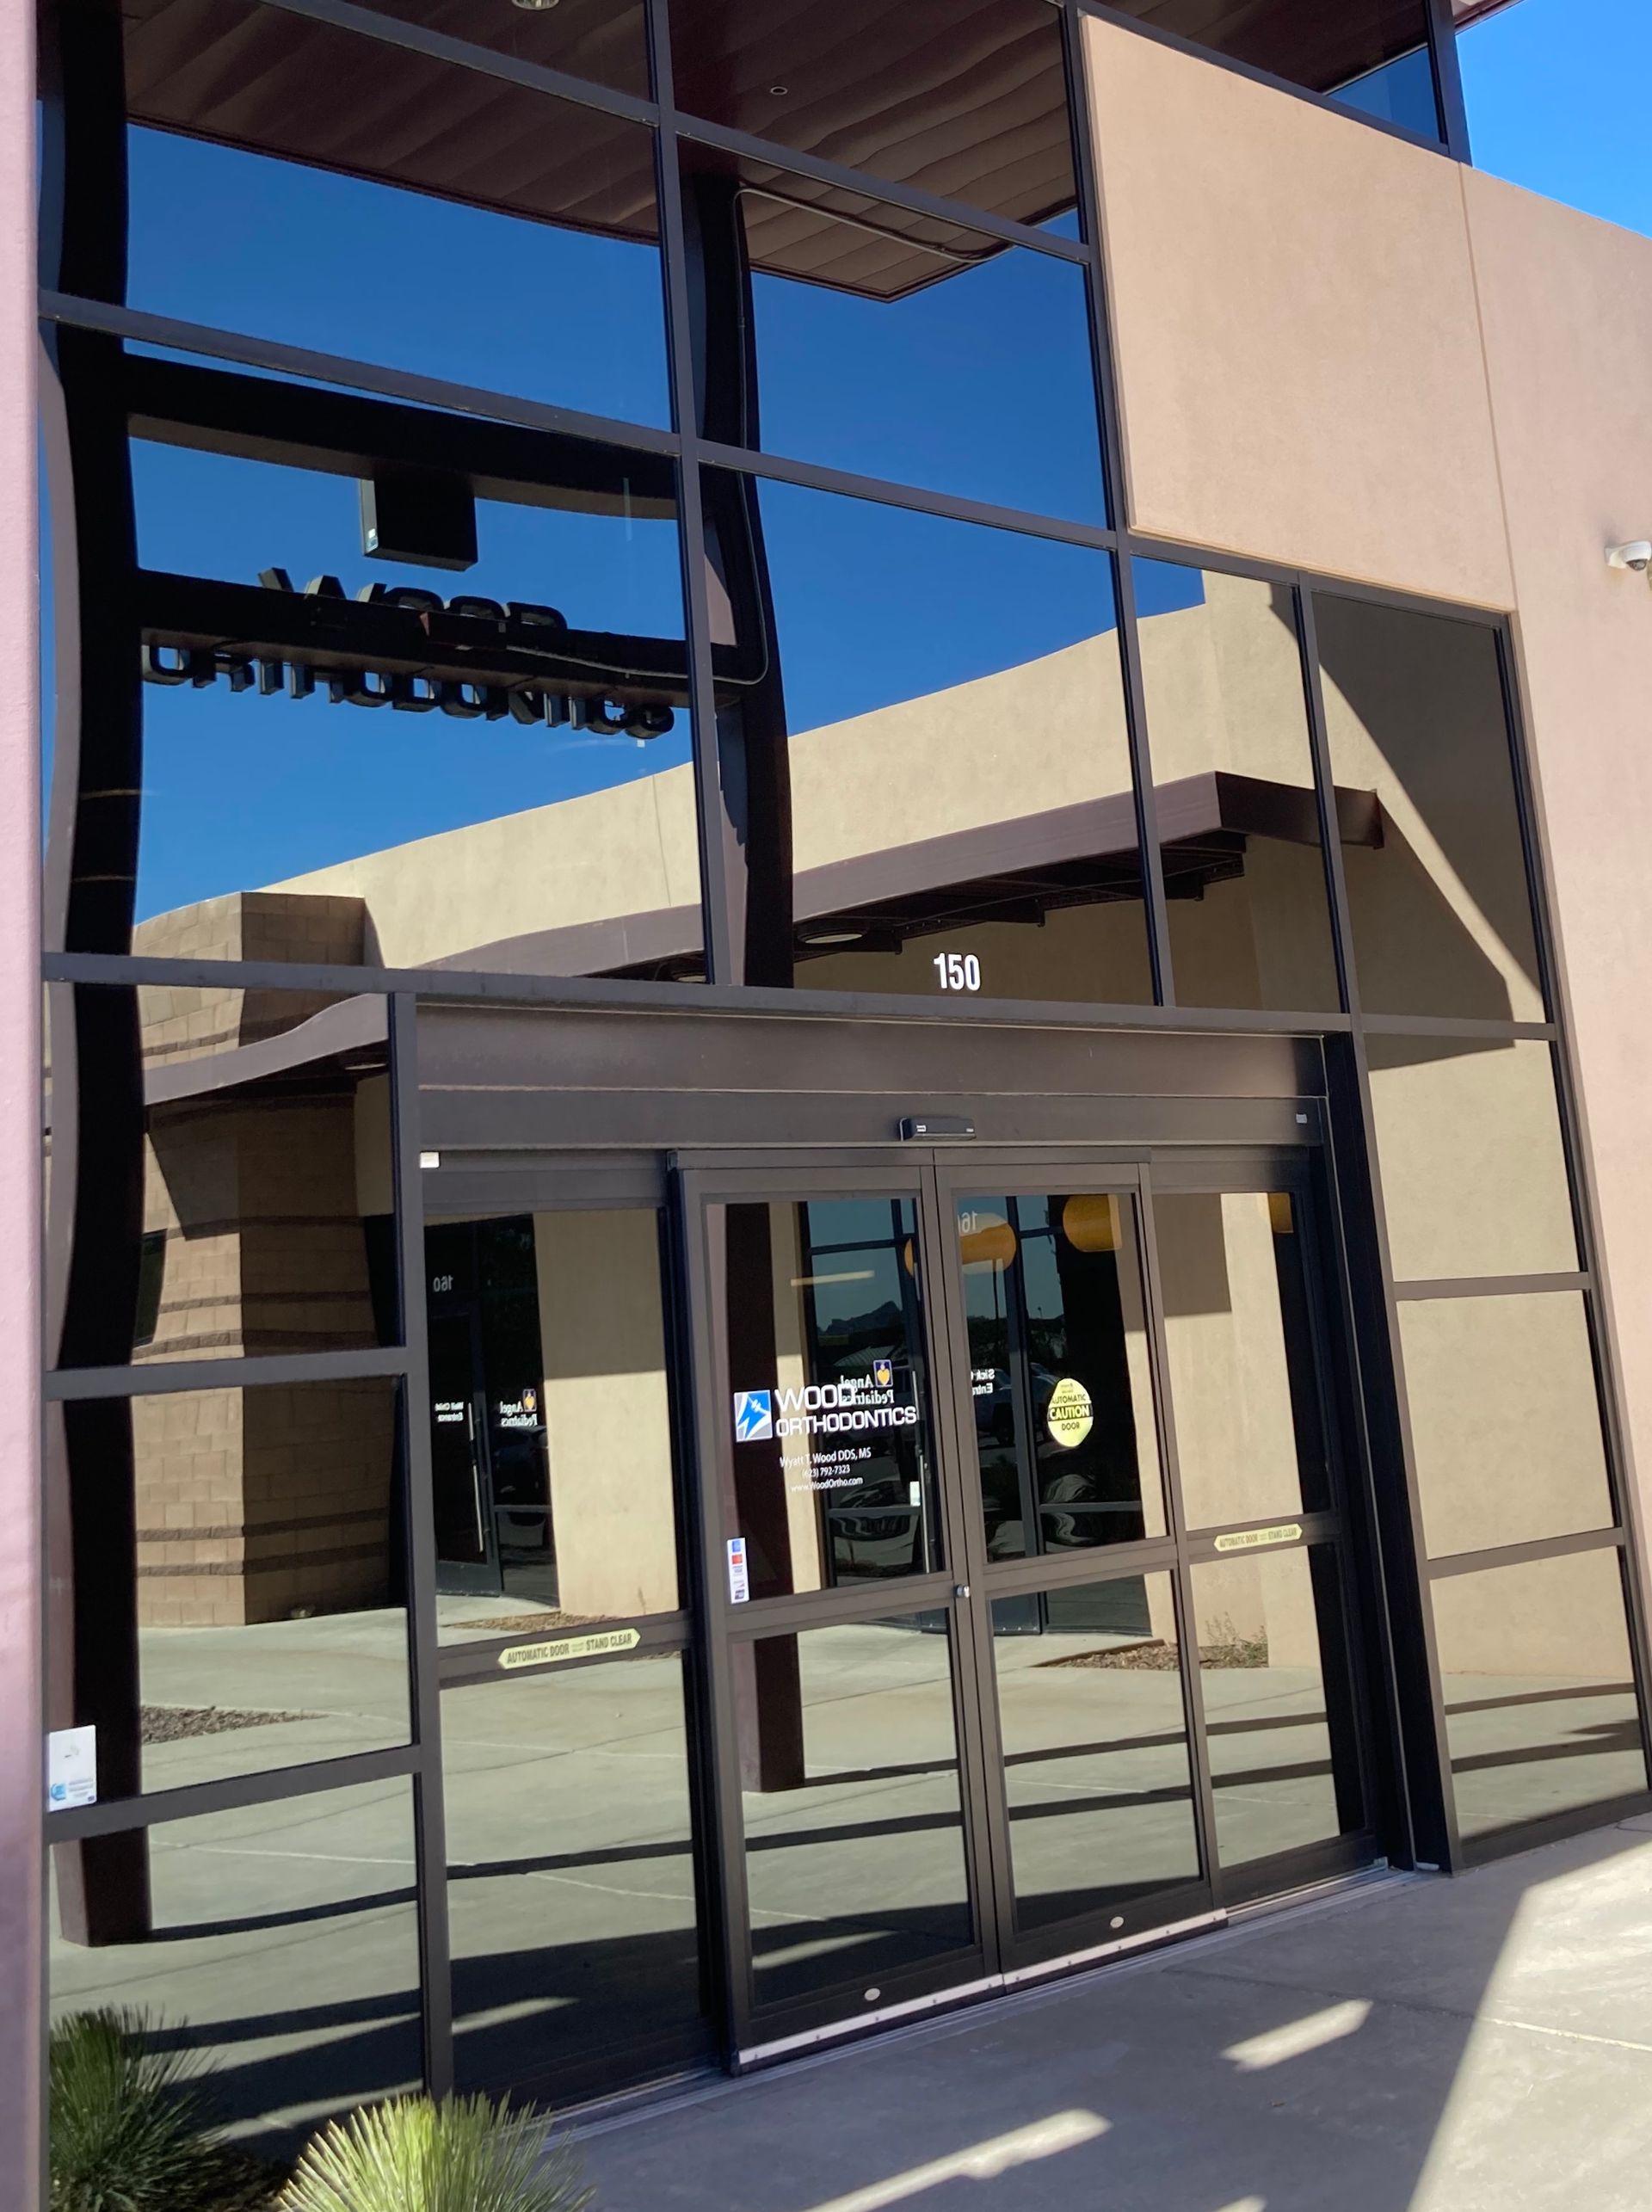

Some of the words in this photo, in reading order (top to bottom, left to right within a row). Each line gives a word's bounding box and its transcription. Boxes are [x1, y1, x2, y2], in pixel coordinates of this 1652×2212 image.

[934, 952, 981, 991] 150
[775, 1383, 855, 1413] WOOD
[1052, 1394, 1086, 1404] AUTOMATIC
[775, 1406, 917, 1437] ORTHODONTICS
[1050, 1404, 1090, 1420] CAUTION
[1062, 1422, 1080, 1431] DOOR
[780, 1456, 804, 1469] Wyatt
[812, 1451, 836, 1465] Wood
[838, 1448, 858, 1462] DDS,
[859, 1447, 872, 1459] MS
[820, 1464, 851, 1476] 792-7323
[791, 1477, 863, 1493] www.WoodOrtho.com
[507, 1648, 549, 1664] AUTOMATIC
[550, 1643, 570, 1657] DOOR
[586, 1638, 608, 1651] STAND
[610, 1633, 632, 1646] CLEAR
